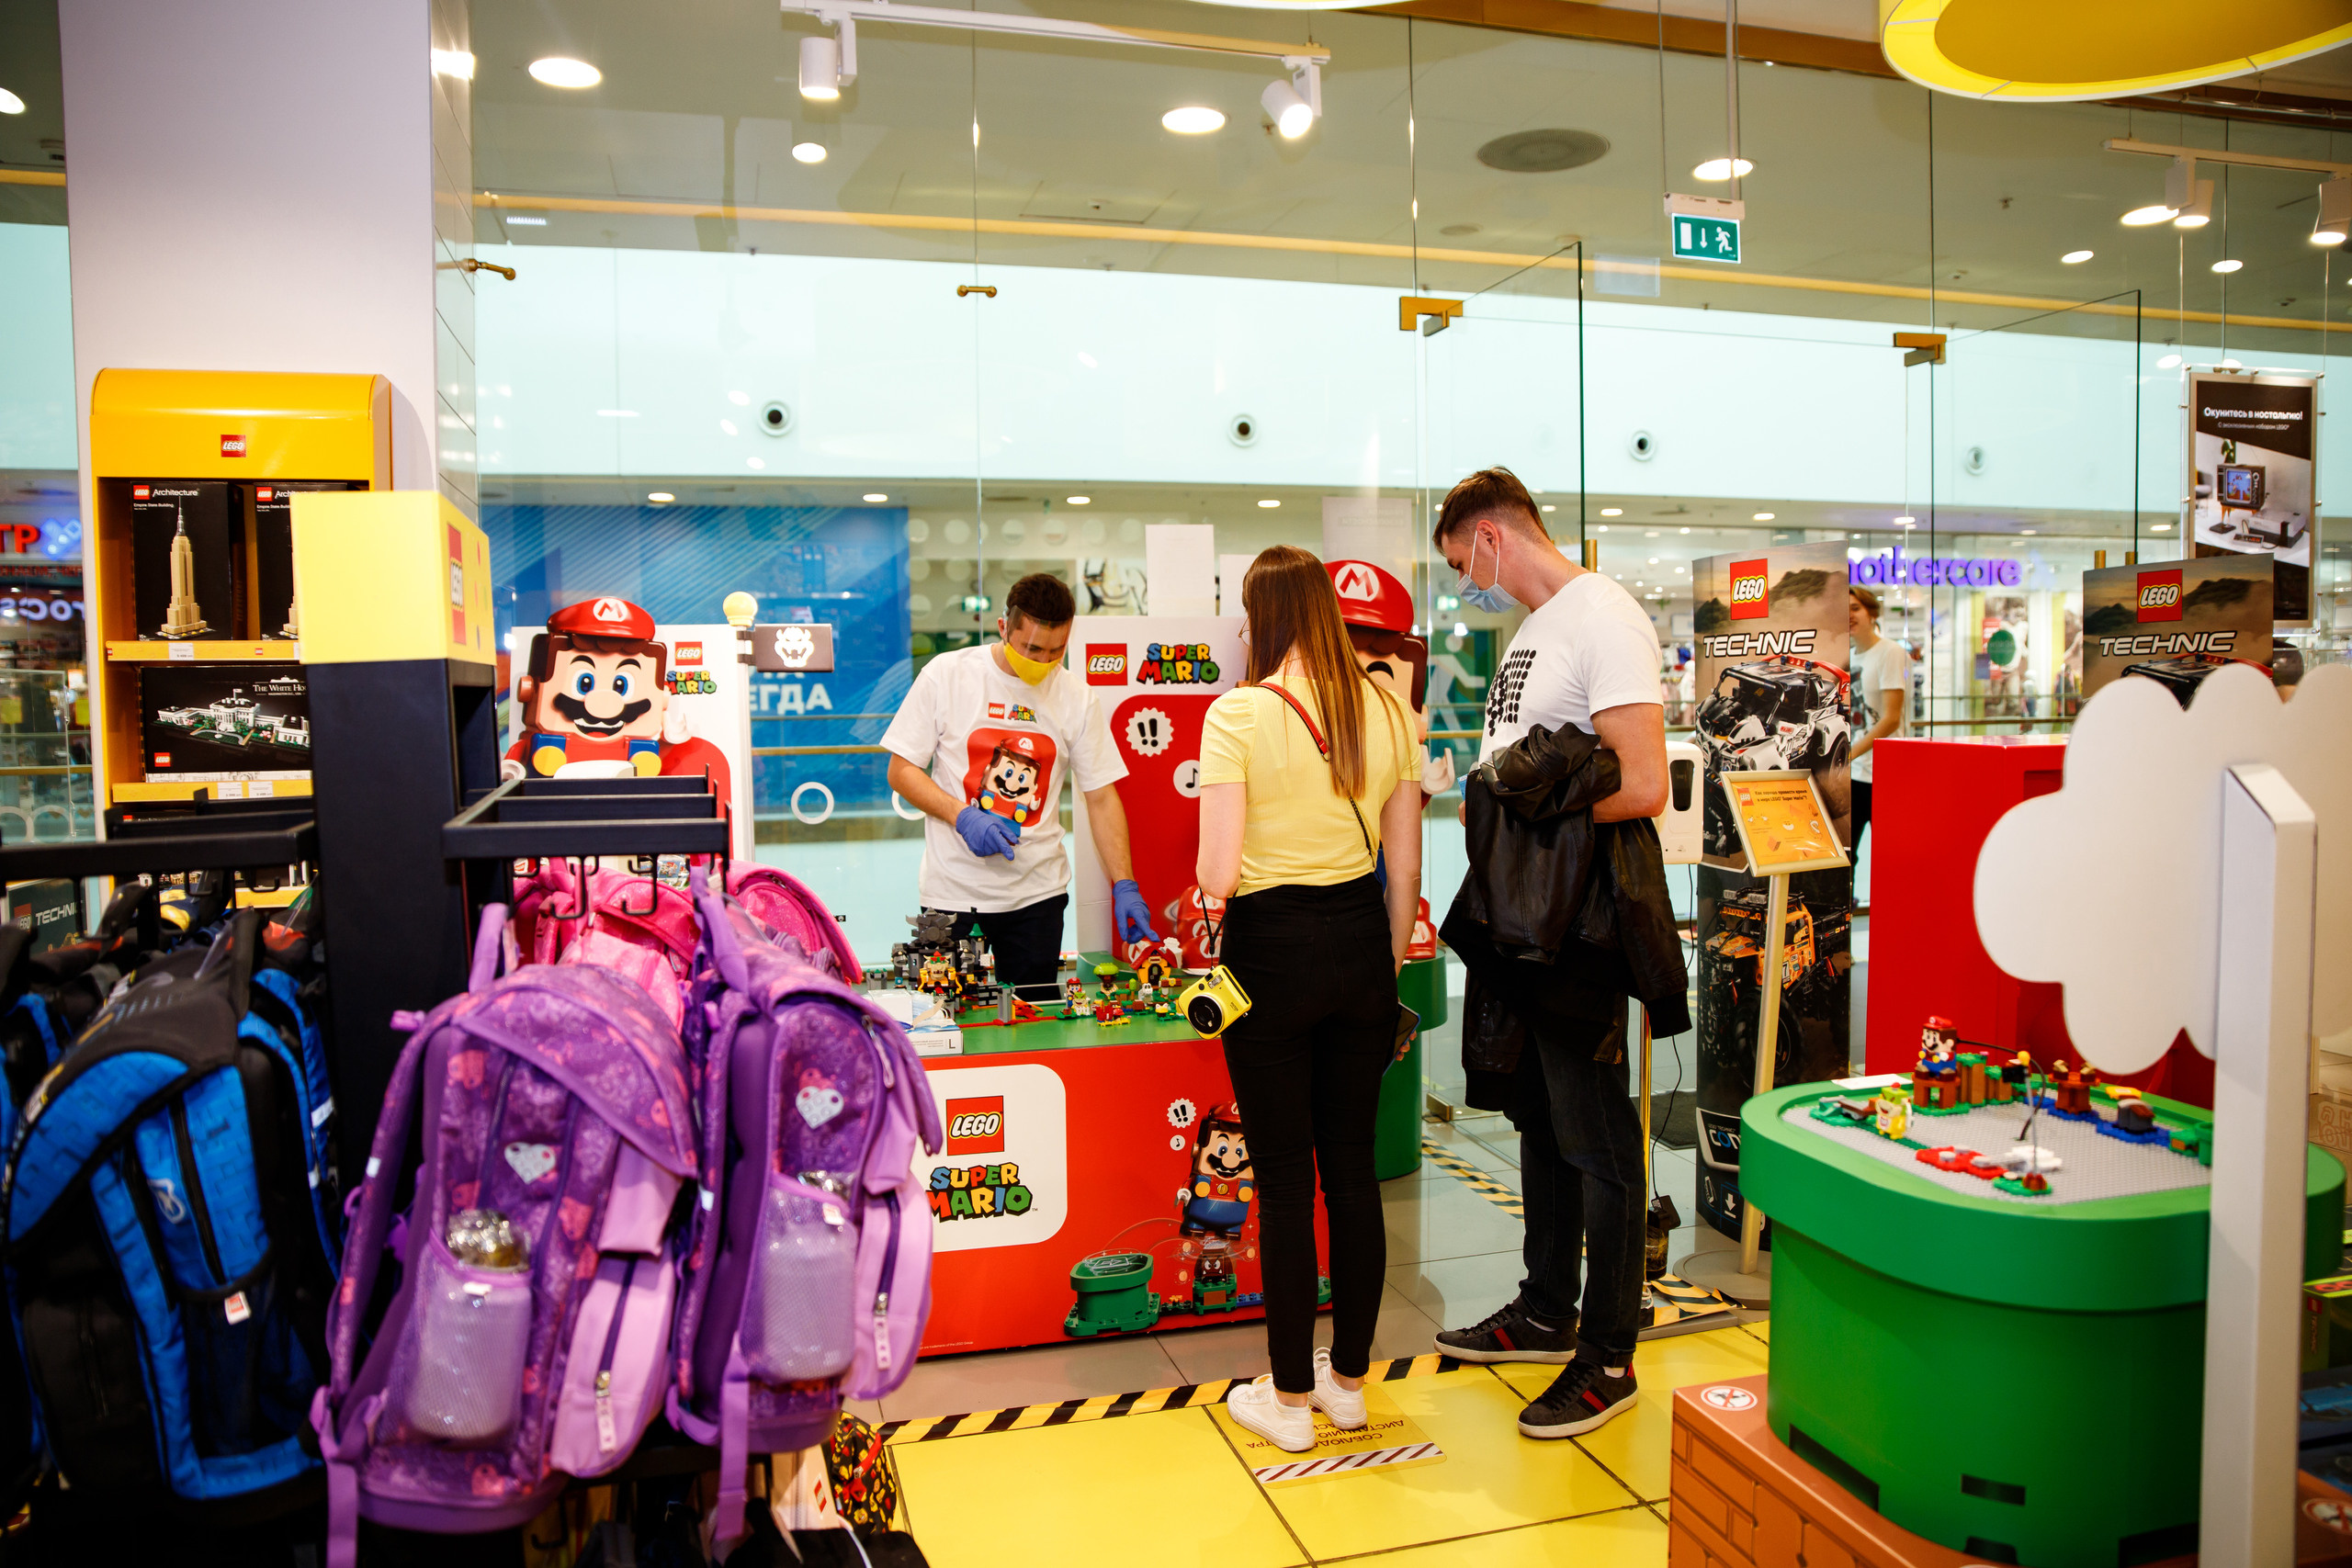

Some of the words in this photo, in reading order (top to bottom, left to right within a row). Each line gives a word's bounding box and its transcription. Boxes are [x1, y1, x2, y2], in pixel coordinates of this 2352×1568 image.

[2204, 407, 2247, 419] Окунитесь
[2255, 411, 2302, 421] ностальгию!
[222, 441, 244, 451] LEGO
[152, 489, 198, 497] Architecture
[1733, 577, 1765, 602] LEGO
[2141, 585, 2179, 606] LEGO
[1147, 643, 1210, 661] SUPER
[1703, 629, 1816, 658] TECHNIC
[2100, 630, 2237, 657] TECHNIC
[676, 648, 701, 659] LEGO
[1089, 656, 1125, 673] LEGO
[1136, 660, 1220, 684] MARIO
[666, 671, 710, 682] SUPER
[663, 680, 717, 695] MARIO
[36, 902, 77, 926] TECHNI
[949, 1039, 956, 1049] L
[950, 1112, 1001, 1138] LEGO
[930, 1162, 1020, 1190] SUPER
[926, 1185, 1033, 1223] MARIO
[1246, 1440, 1273, 1449] ТРА
[1314, 1433, 1383, 1449] СОБЛЮДА
